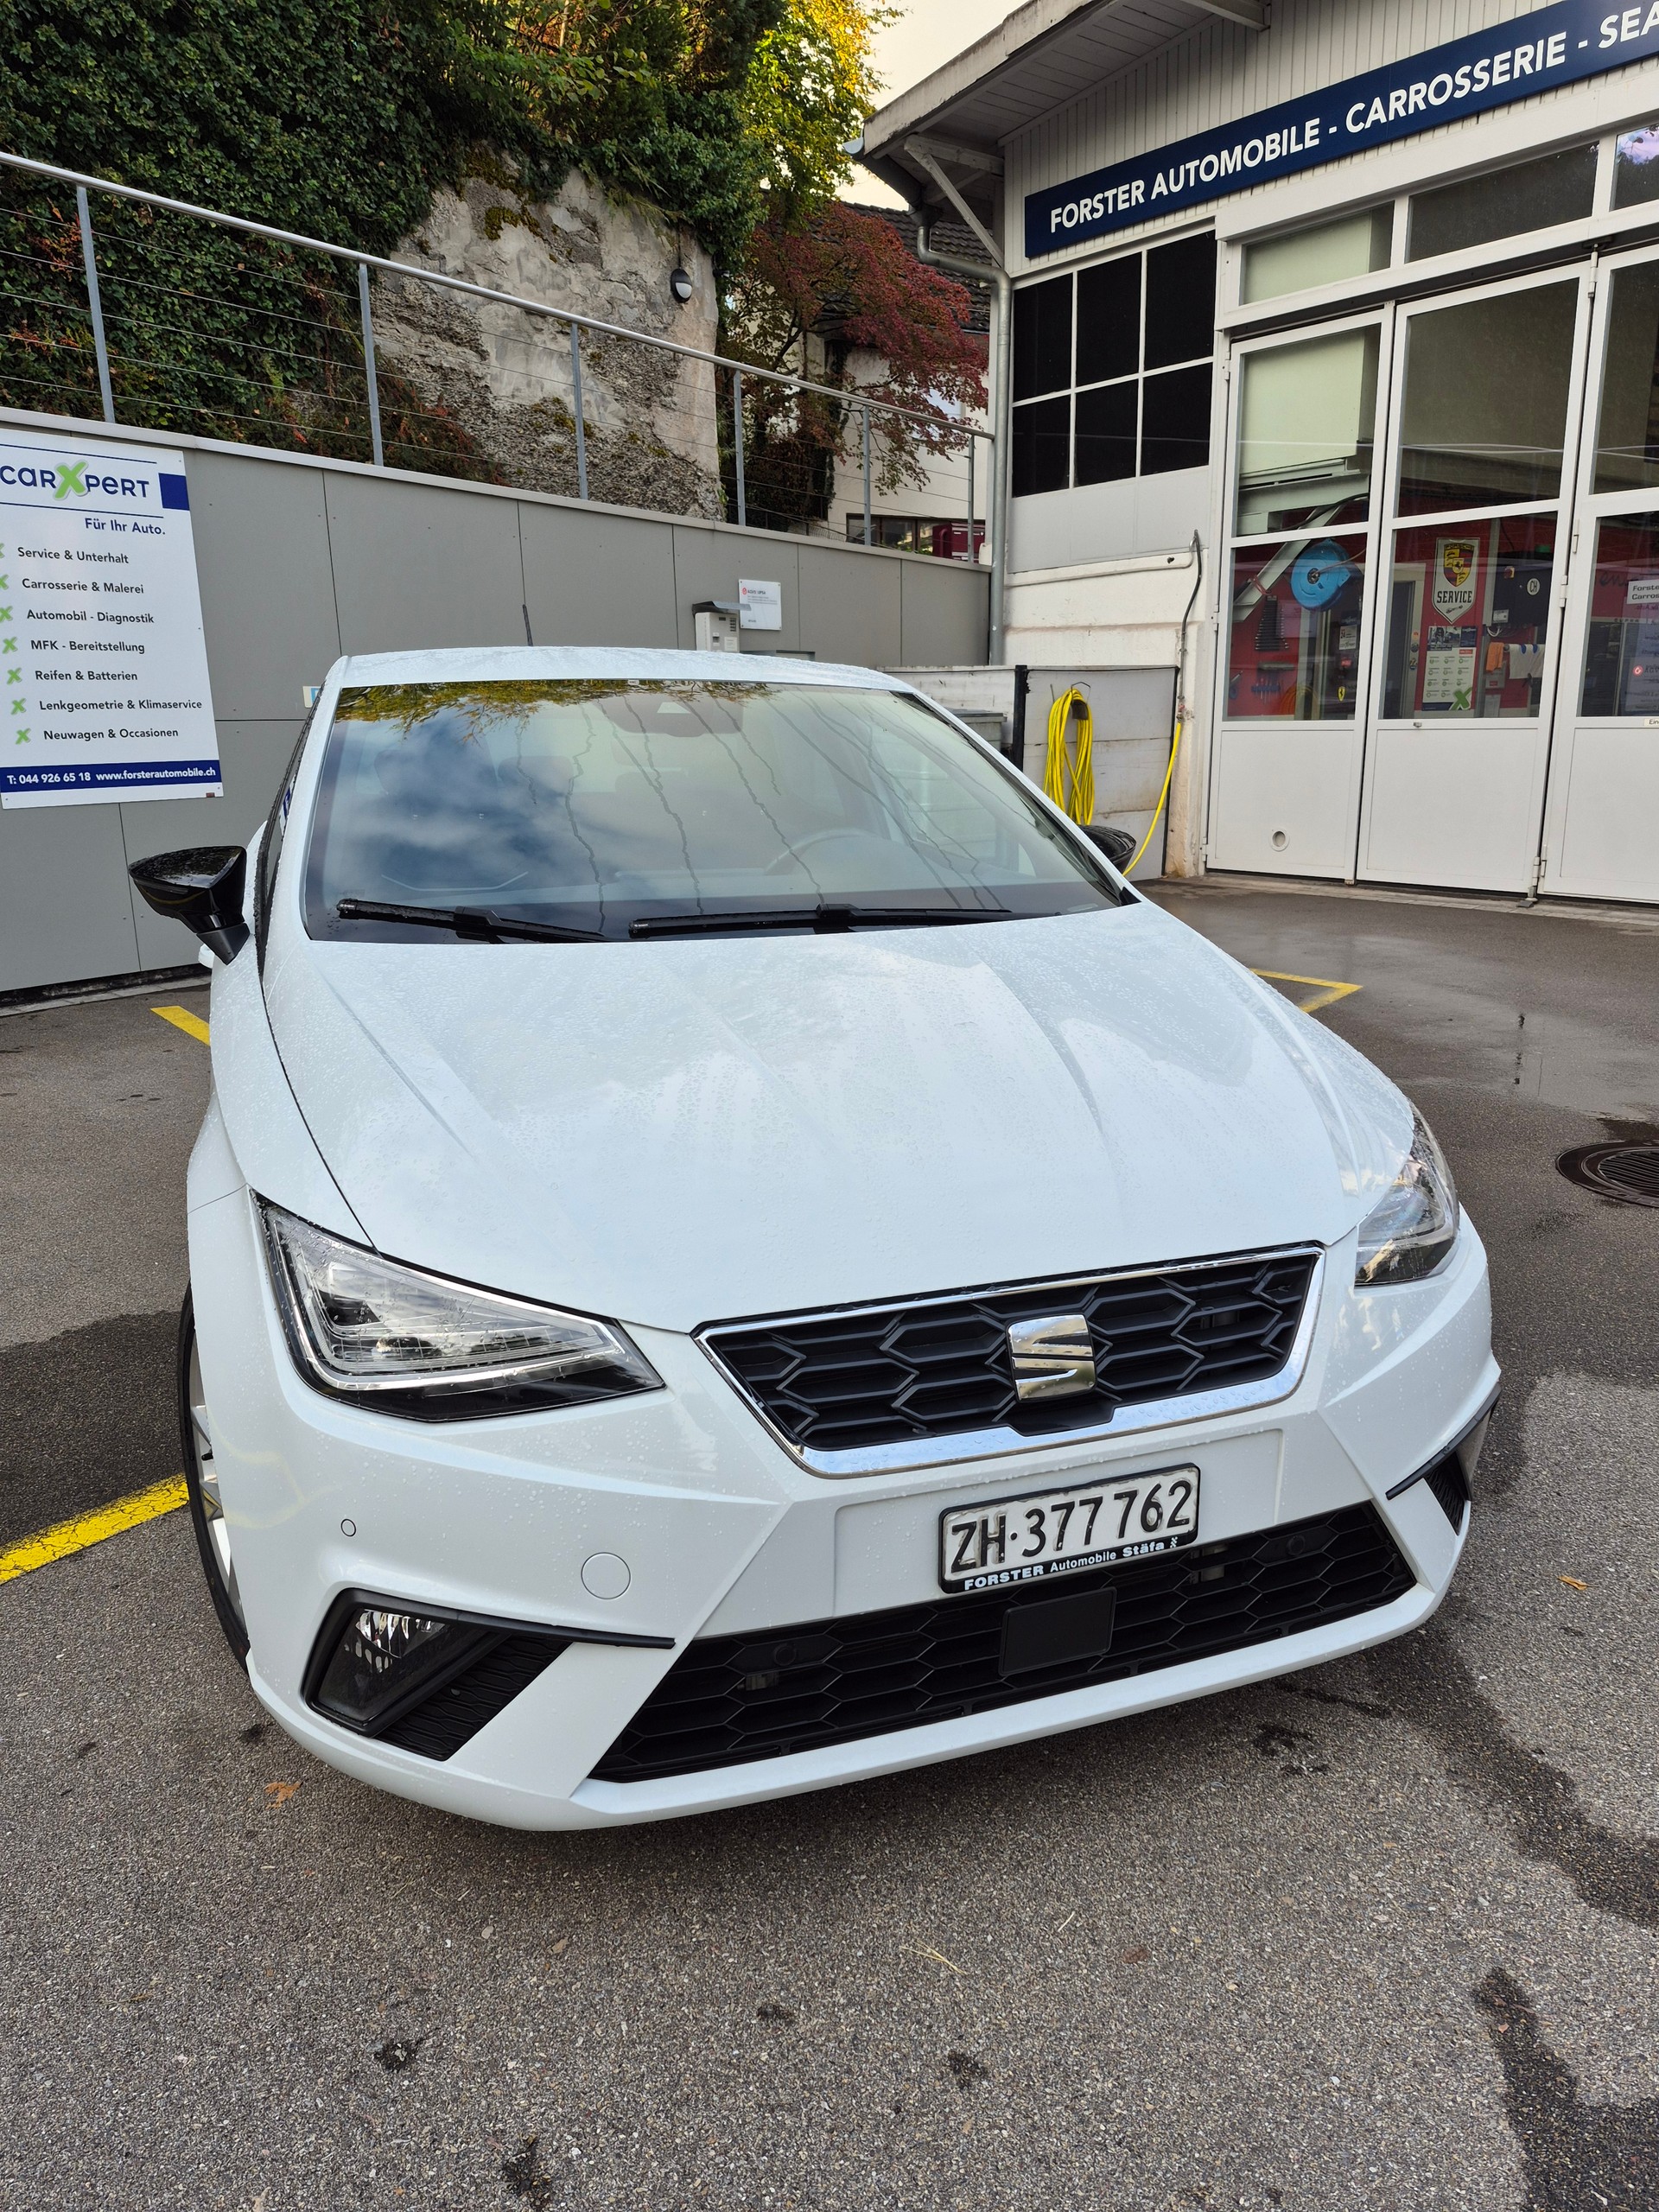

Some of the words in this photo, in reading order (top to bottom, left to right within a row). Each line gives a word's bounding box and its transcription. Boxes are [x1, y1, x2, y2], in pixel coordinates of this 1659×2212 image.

[1050, 179, 1145, 234] FORSTER
[1151, 118, 1321, 200] AUTOMOBILE
[1345, 32, 1567, 135] CARROSSERIE
[1598, 1, 1659, 49] SEA
[85, 518, 106, 531] Für
[111, 519, 128, 532] Ihr
[131, 522, 166, 535] Auto.
[17, 546, 60, 560] Service
[64, 550, 73, 560] &
[76, 550, 130, 563] Unterhalt
[22, 578, 88, 591] Carrosserie
[91, 582, 100, 592] &
[103, 582, 144, 594] Malerei
[1529, 577, 1538, 593] CH
[1436, 590, 1473, 603] SERVICE
[27, 609, 87, 621] Automobil
[97, 612, 155, 625] Diagnostik
[30, 639, 59, 651] MFK
[69, 640, 145, 654] Bereitstellung
[35, 670, 72, 681] Reifen
[75, 671, 85, 681] &
[87, 671, 138, 681] Batterien
[39, 700, 124, 713] Lenkgeometrie
[126, 699, 136, 710] &
[138, 699, 203, 710] Klimaservice
[43, 729, 105, 741] Neuwagen
[107, 728, 117, 739] &
[119, 728, 179, 739] Occasionen
[7, 774, 17, 785] T:
[18, 774, 39, 785] 044
[41, 773, 60, 783] 926
[62, 772, 76, 783] 65
[78, 772, 92, 782] 18
[95, 766, 216, 781] www.forsterautomobile.ch
[963, 1564, 1044, 1592] FORSTER
[1049, 1551, 1117, 1573] Automobile
[1122, 1540, 1165, 1558] Stäfa
